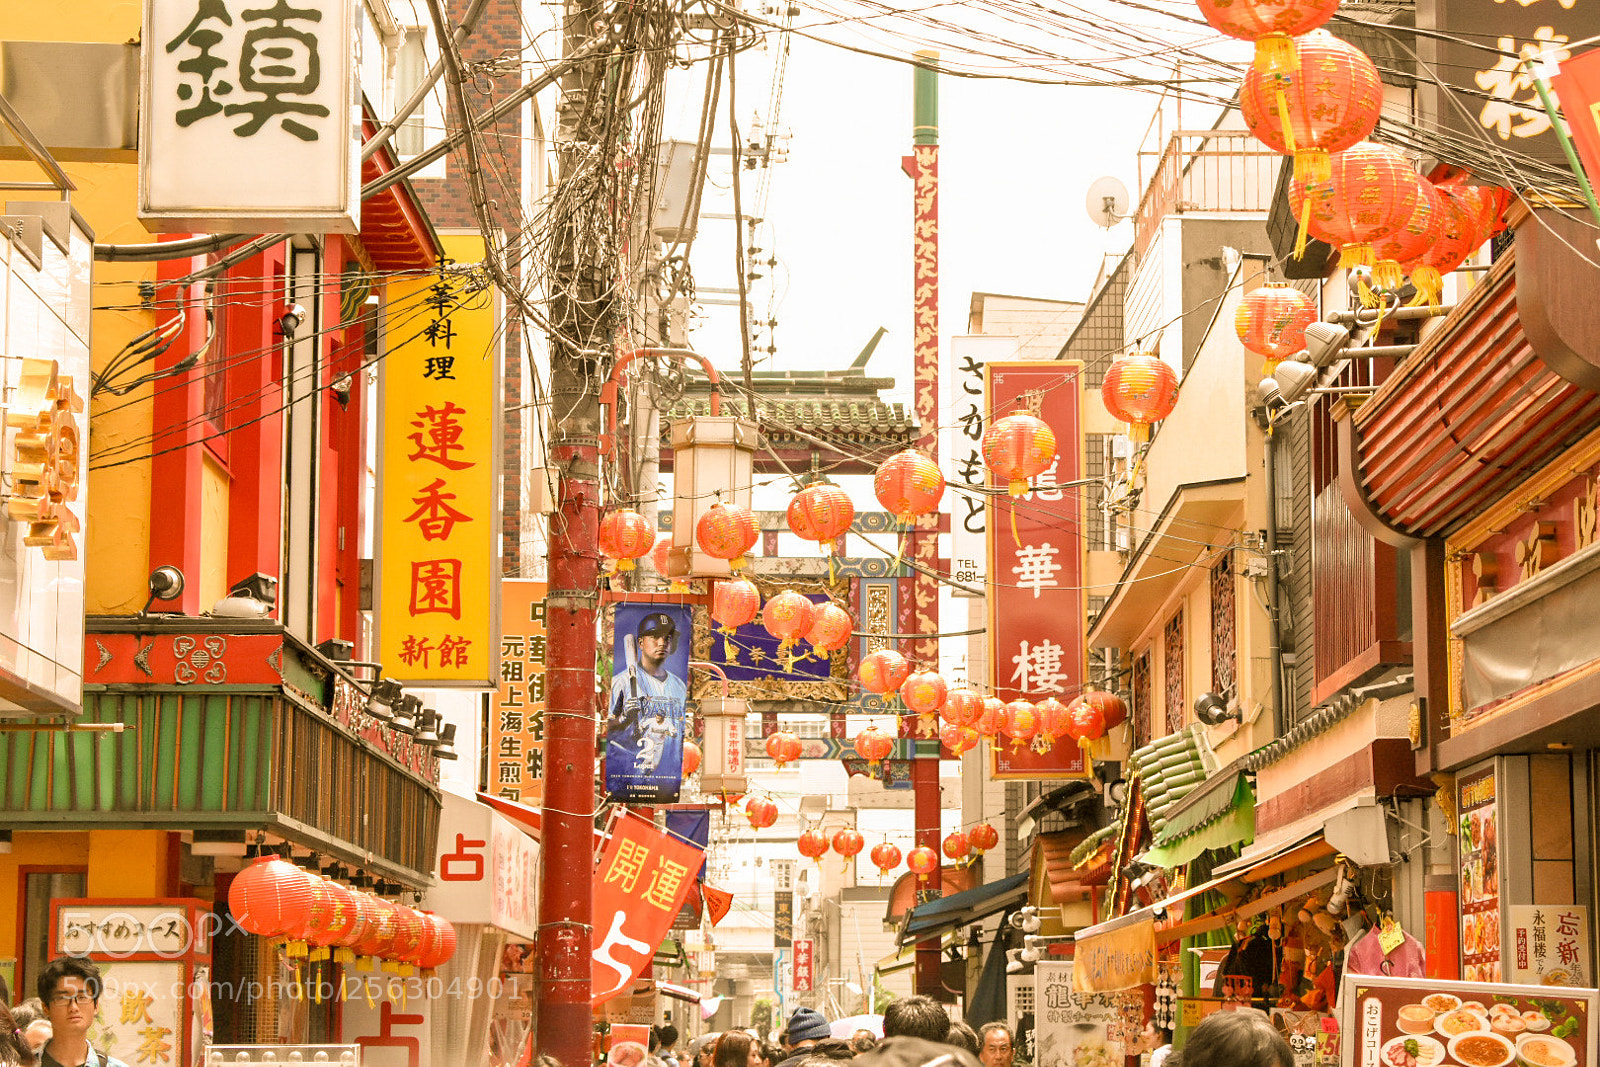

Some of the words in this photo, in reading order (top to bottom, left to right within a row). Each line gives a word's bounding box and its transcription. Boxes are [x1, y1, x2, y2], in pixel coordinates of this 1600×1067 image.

[1474, 0, 1575, 140] 楼
[403, 401, 477, 620] 蓮香園
[957, 559, 978, 568] TEL
[399, 634, 472, 669] 新館
[636, 738, 655, 760] 2
[441, 833, 486, 881] 占
[604, 838, 689, 912] 開運
[120, 988, 172, 1063] 飲茶
